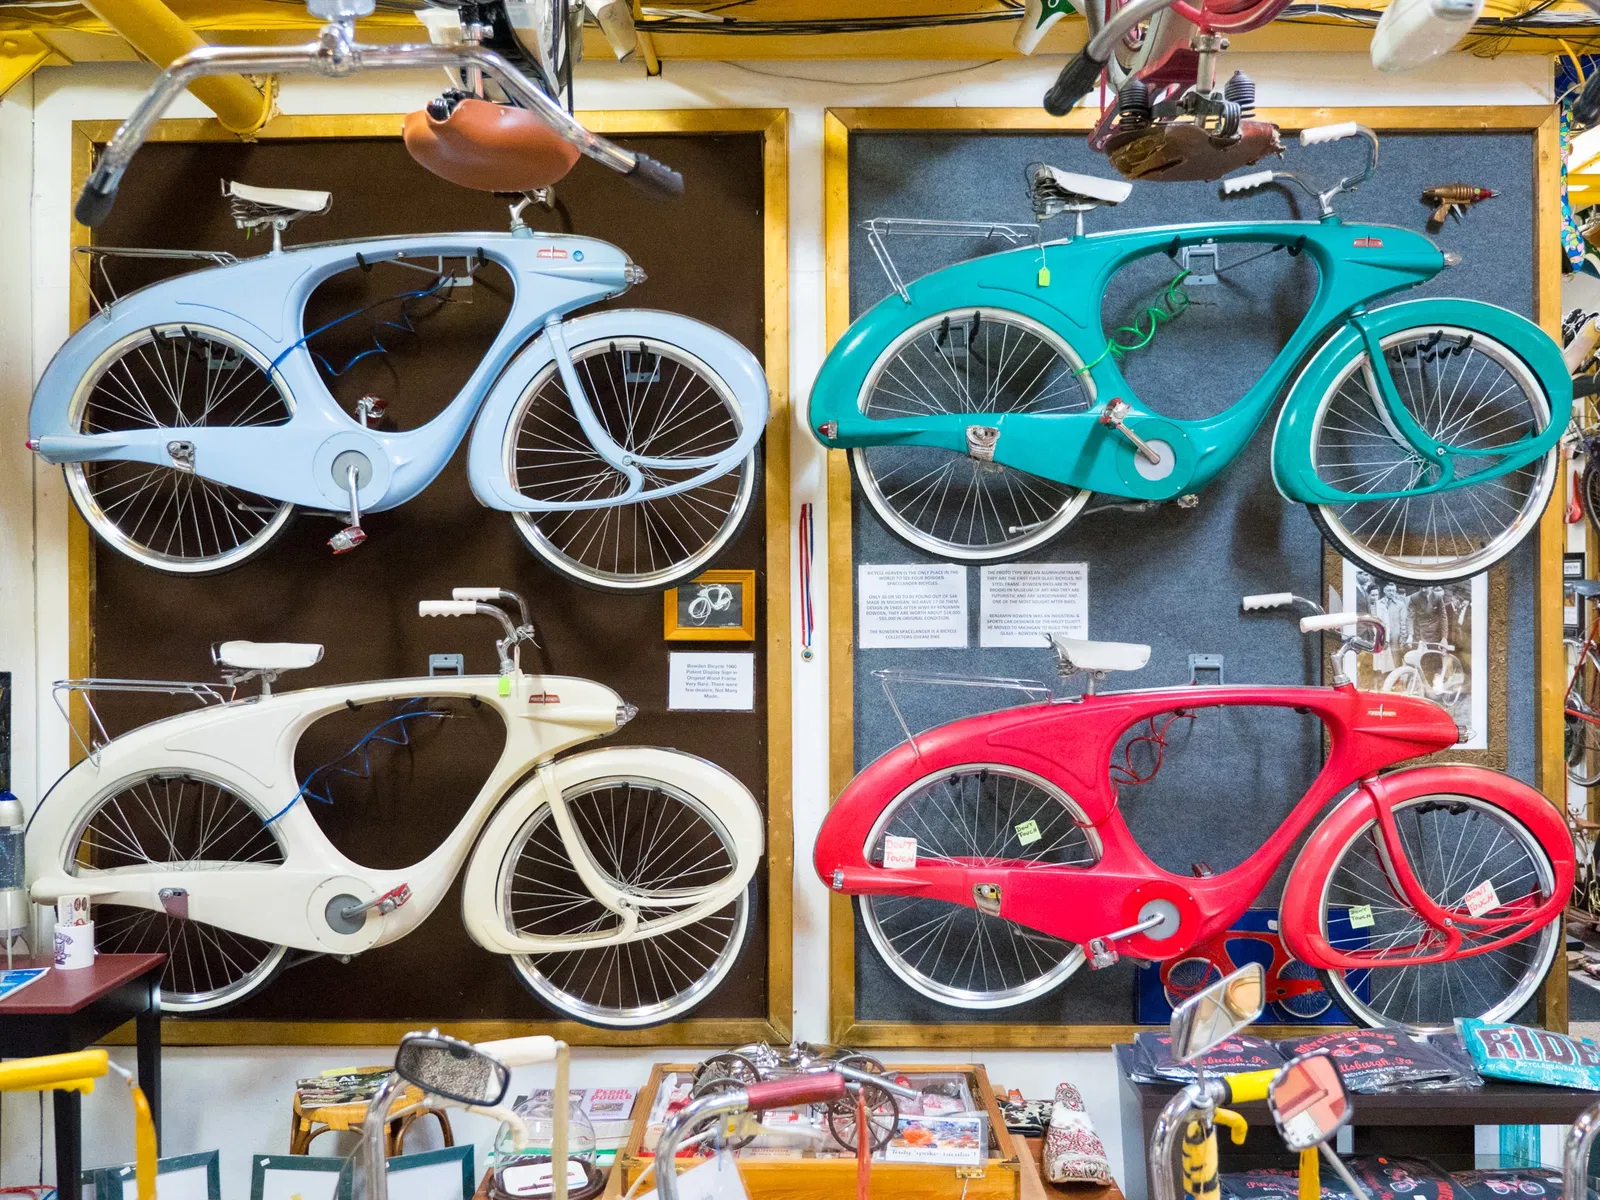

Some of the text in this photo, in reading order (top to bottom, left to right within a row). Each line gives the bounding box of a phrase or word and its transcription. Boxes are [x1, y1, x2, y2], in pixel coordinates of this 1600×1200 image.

[1018, 828, 1037, 837] TOUCH
[886, 852, 914, 862] TOUCH
[1469, 894, 1494, 912] TOUCH
[1294, 1031, 1395, 1054] BICYCLE HEAVEN
[1475, 1027, 1600, 1066] RIDE
[1251, 1056, 1268, 1064] Pa
[1395, 1056, 1413, 1065] Pa
